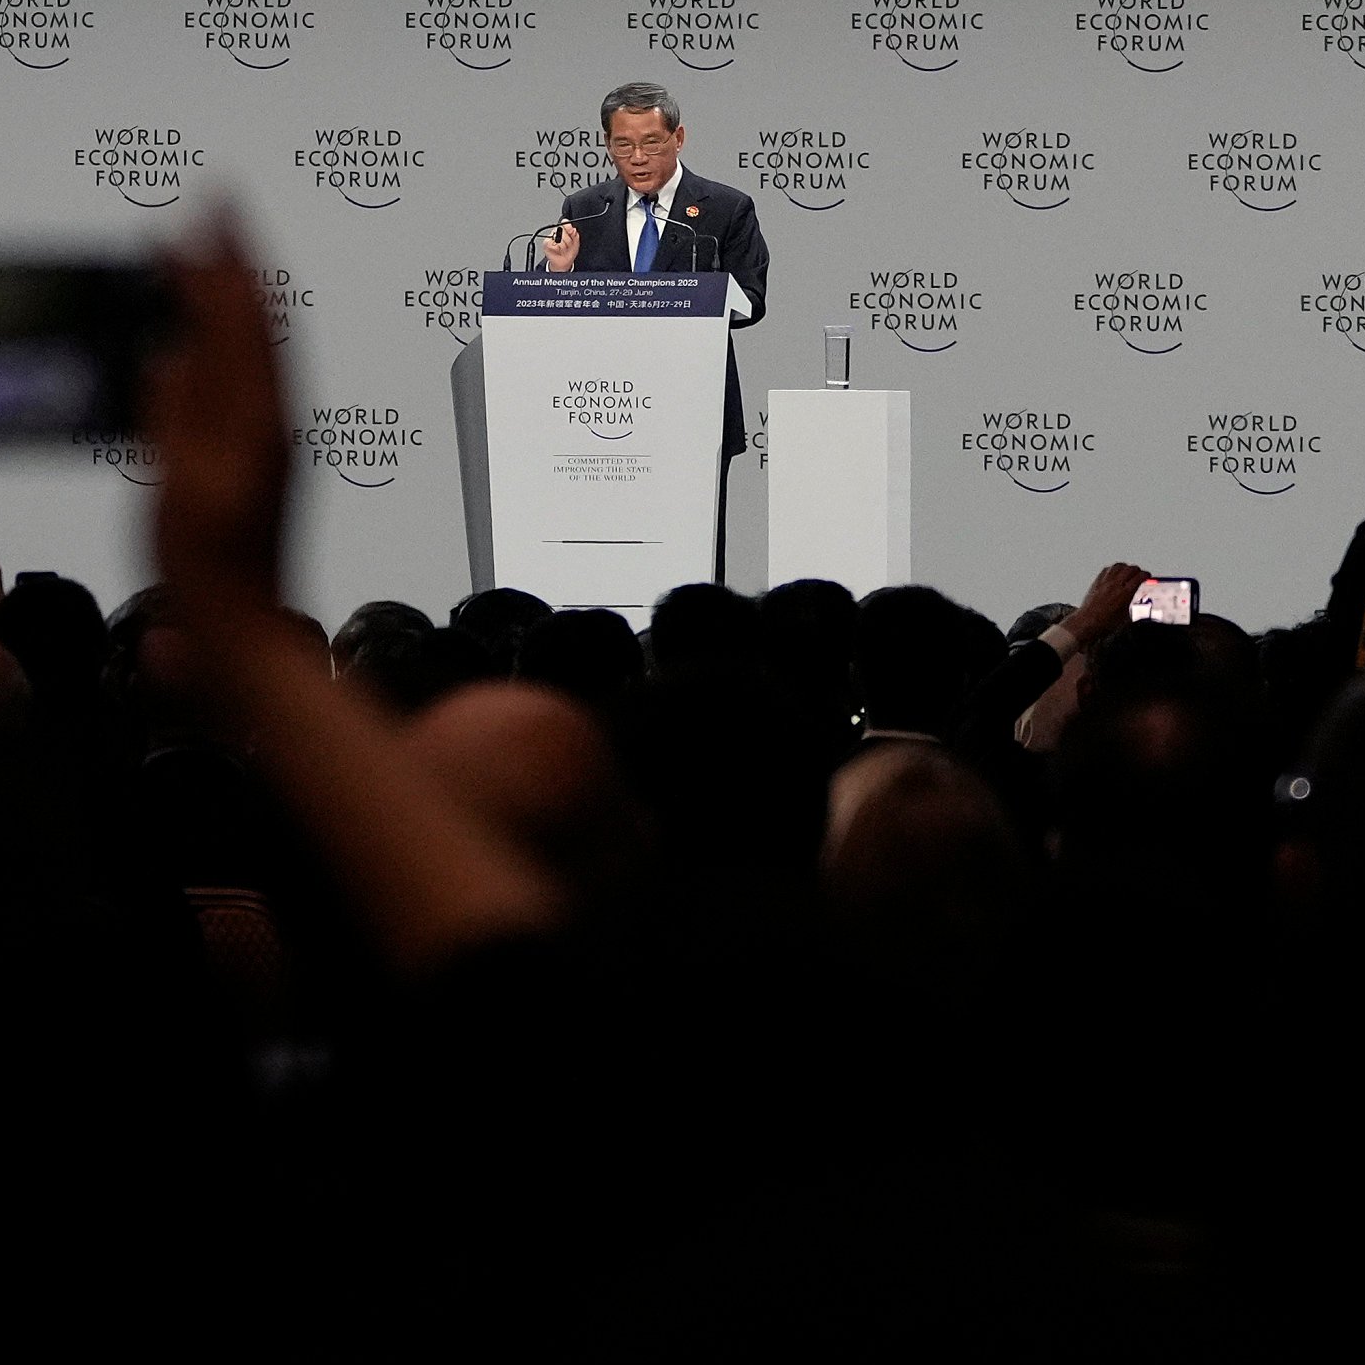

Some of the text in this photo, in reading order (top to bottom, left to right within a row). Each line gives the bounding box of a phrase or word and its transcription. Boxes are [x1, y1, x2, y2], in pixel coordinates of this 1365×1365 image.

[184, 11, 315, 29] ECONOMIC
[627, 12, 760, 30] ECONOMIC
[851, 12, 984, 30] ECONOMIC
[1075, 13, 1209, 31] ECONOMIC
[205, 32, 291, 50] FORUM
[648, 33, 735, 51] FORUM
[872, 33, 959, 51] FORUM
[1097, 34, 1185, 52] FORUM
[95, 128, 182, 146] WORLD
[315, 129, 402, 147] WORLD
[758, 131, 847, 149] WORLD
[982, 132, 1071, 150] WORLD
[74, 148, 204, 167] ECONOMIC
[294, 149, 425, 168] ECONOMIC
[738, 151, 870, 170] ECONOMIC
[961, 152, 1095, 170] ECONOMIC
[95, 170, 181, 187] FORUM
[315, 171, 401, 188] FORUM
[759, 172, 847, 190] FORUM
[983, 173, 1071, 191] FORUM
[544, 279, 578, 287] Meeting
[627, 279, 676, 287] Champions
[870, 271, 958, 289] WORLD
[1094, 272, 1184, 291] WORLD
[849, 292, 982, 310] ECONOMIC
[1074, 293, 1208, 312] ECONOMIC
[871, 313, 958, 331] FORUM
[1095, 314, 1183, 333] FORUM
[568, 381, 633, 393] WORLD
[553, 396, 652, 408] ECONOMIC
[569, 412, 633, 424] FORUM
[982, 412, 1072, 430] WORLD
[1208, 414, 1298, 432] WORLD
[961, 433, 1095, 452] ECONOMIC
[1187, 435, 1322, 454] ECONOMIC
[983, 454, 1071, 472] FORUM
[1209, 456, 1297, 474] FORUM
